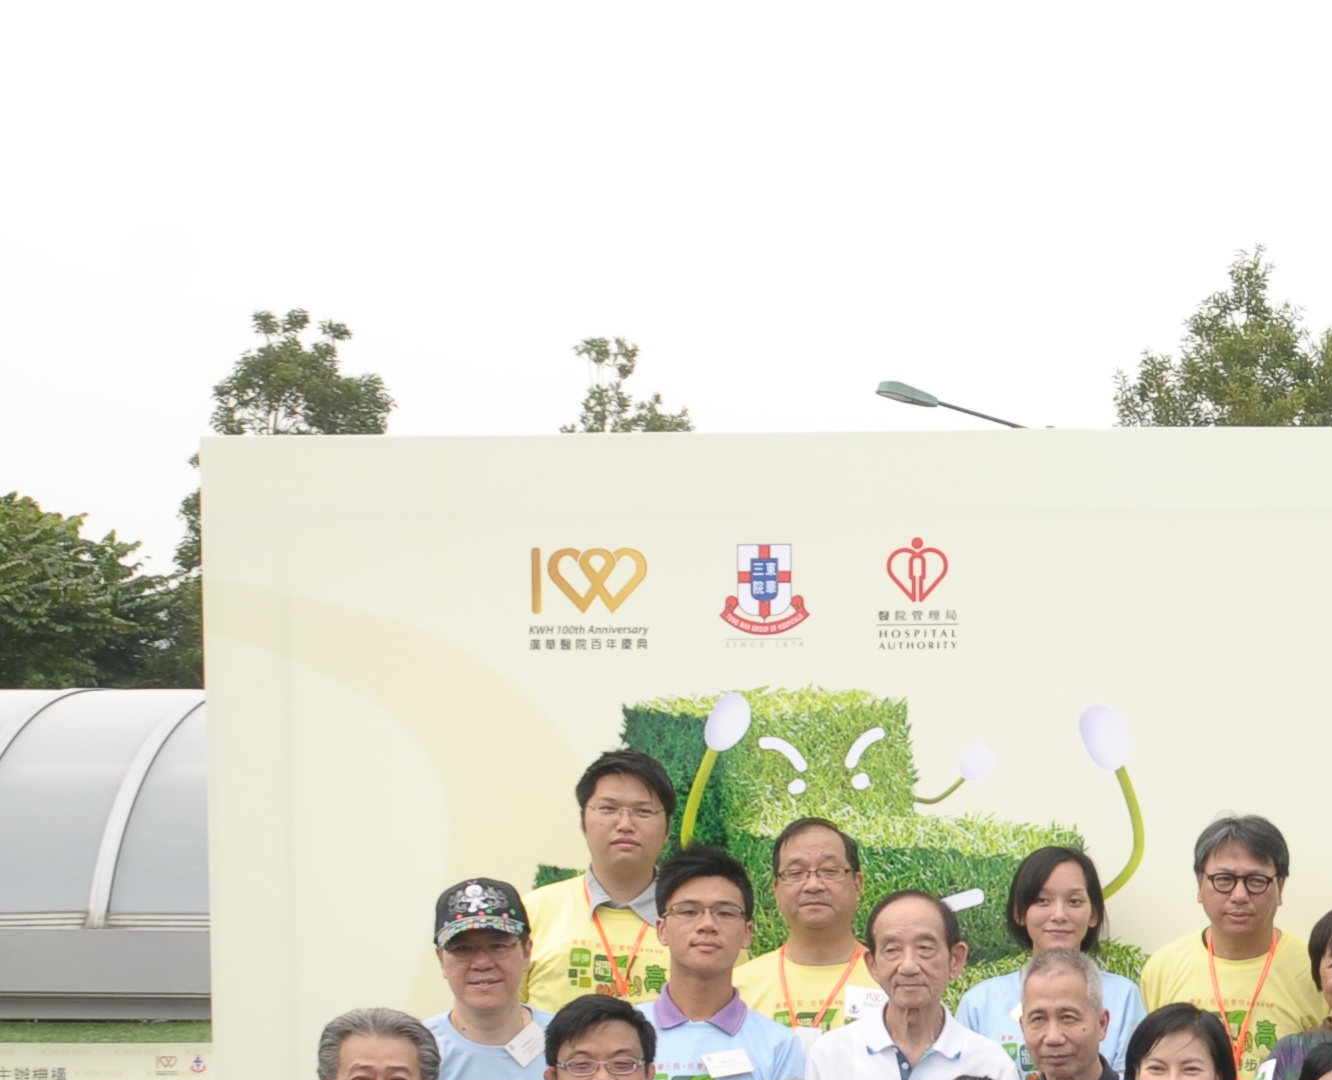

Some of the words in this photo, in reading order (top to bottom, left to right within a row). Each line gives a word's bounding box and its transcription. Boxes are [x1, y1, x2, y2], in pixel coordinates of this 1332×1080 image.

[878, 610, 958, 622] 醫院管理局
[528, 625, 553, 635] KWH
[556, 625, 585, 635] 100th
[587, 625, 649, 637] Anniversary
[878, 629, 958, 639] HOSPITAL
[529, 638, 649, 651] 廣華醫院百年慶典
[878, 641, 958, 650] AUTHORITY
